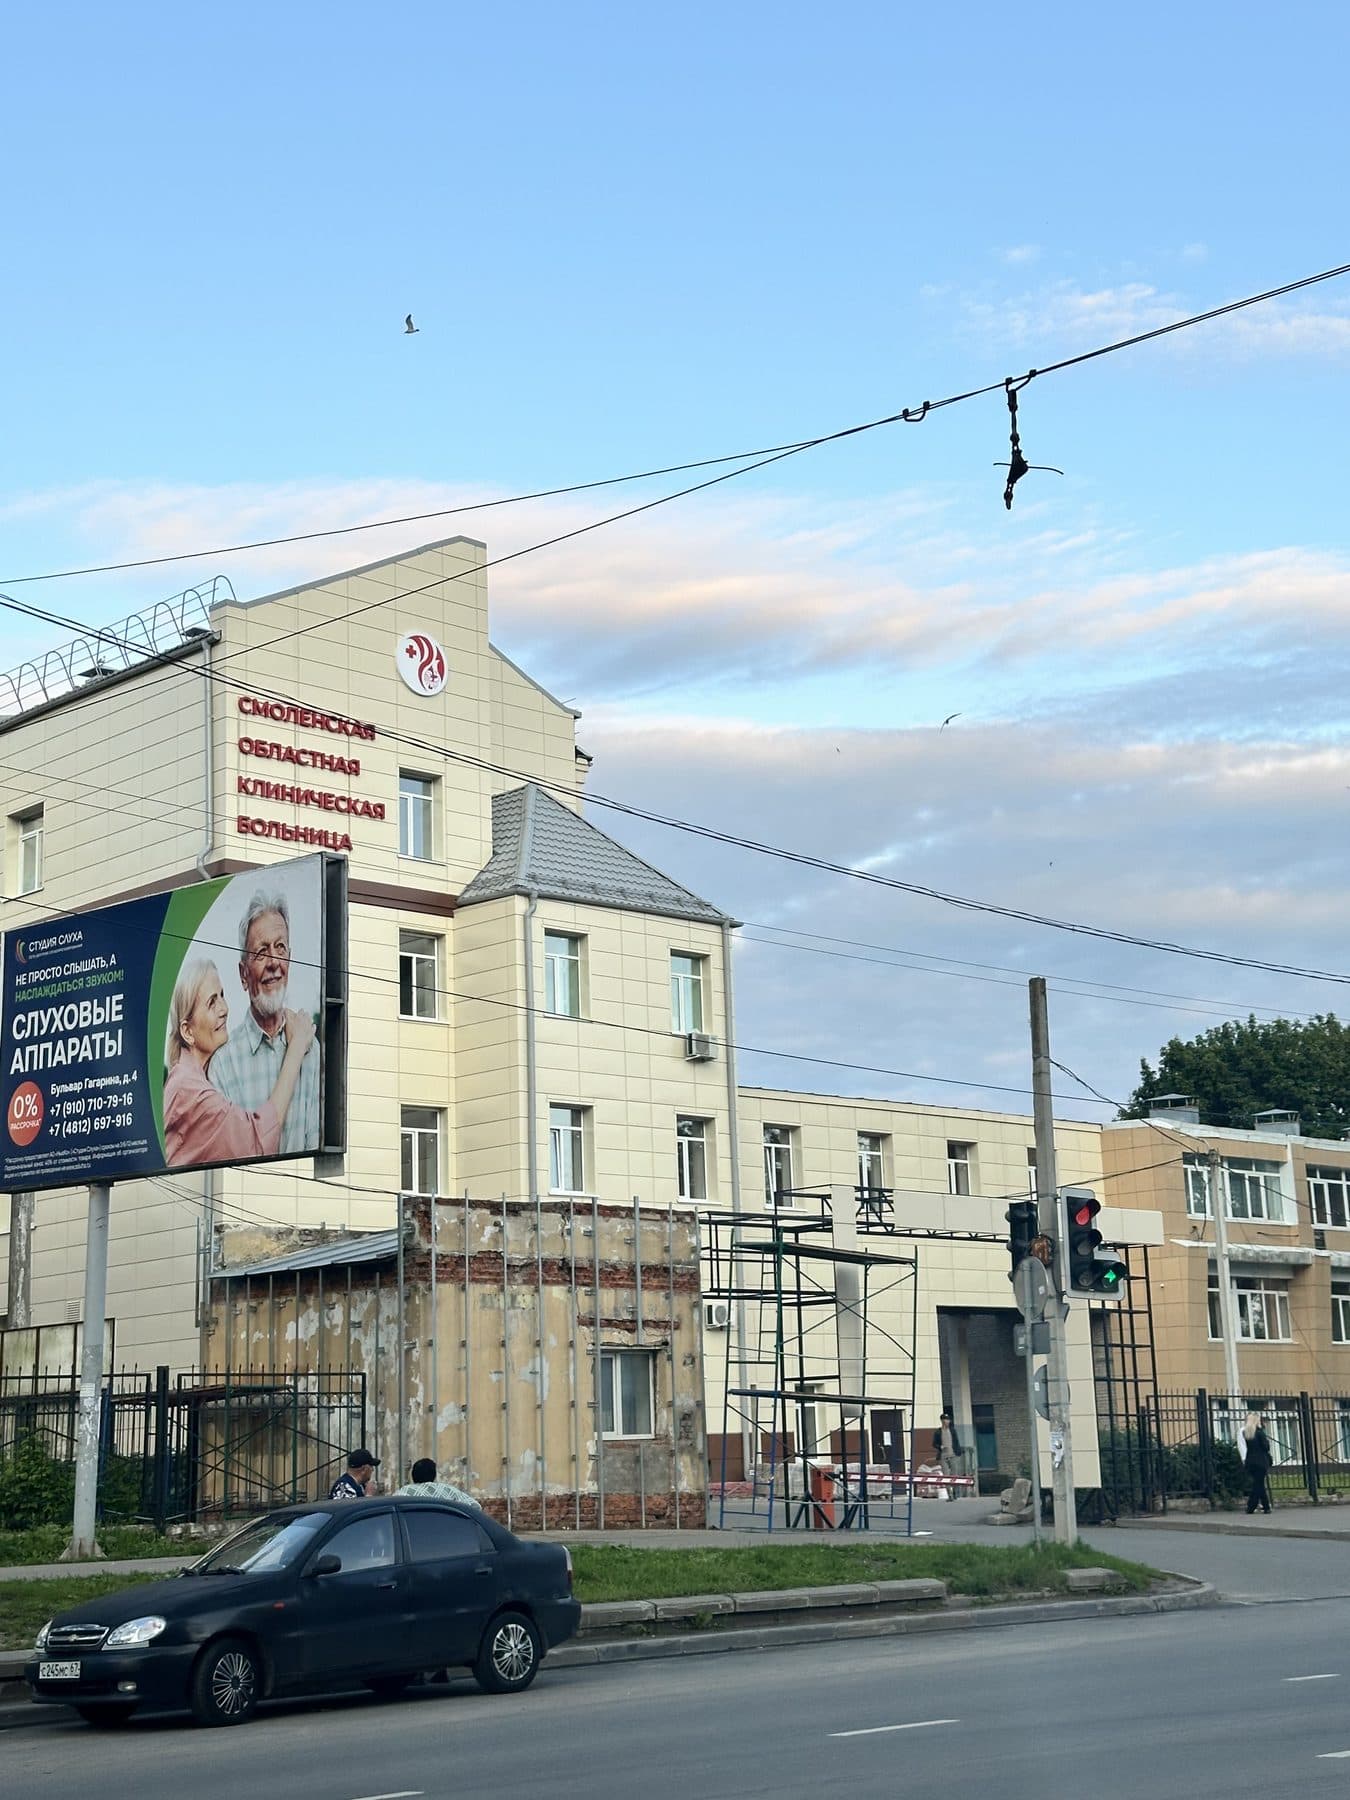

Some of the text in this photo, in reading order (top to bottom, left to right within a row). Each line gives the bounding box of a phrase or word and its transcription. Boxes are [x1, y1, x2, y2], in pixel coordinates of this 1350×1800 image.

[238, 696, 375, 740] СМОЛЕНСКАЯ
[238, 737, 360, 776] ОБЛАСТНАЯ
[237, 776, 385, 819] КЛИНИЧЕСКАЯ
[237, 815, 353, 851] БОЛЬНИЦА
[28, 937, 57, 953] СТУДИЯ
[58, 930, 83, 946] СЛУХА
[15, 953, 117, 986] НЕ ПРОСТО СЛЫШАТЬ, А
[15, 969, 124, 1002] НАСЛАЖДАТЬСЯ ЗВУКОМ!
[12, 994, 124, 1040] СЛУХОВЫЕ
[10, 1028, 123, 1075] АППАРАТЫ
[50, 1070, 138, 1097] Бульвар Гагарина, д. 4
[13, 1093, 38, 1119] 0%
[49, 1092, 133, 1118] +7 (910) 710-79-16
[48, 1112, 133, 1138] +7 (4812) 697-916
